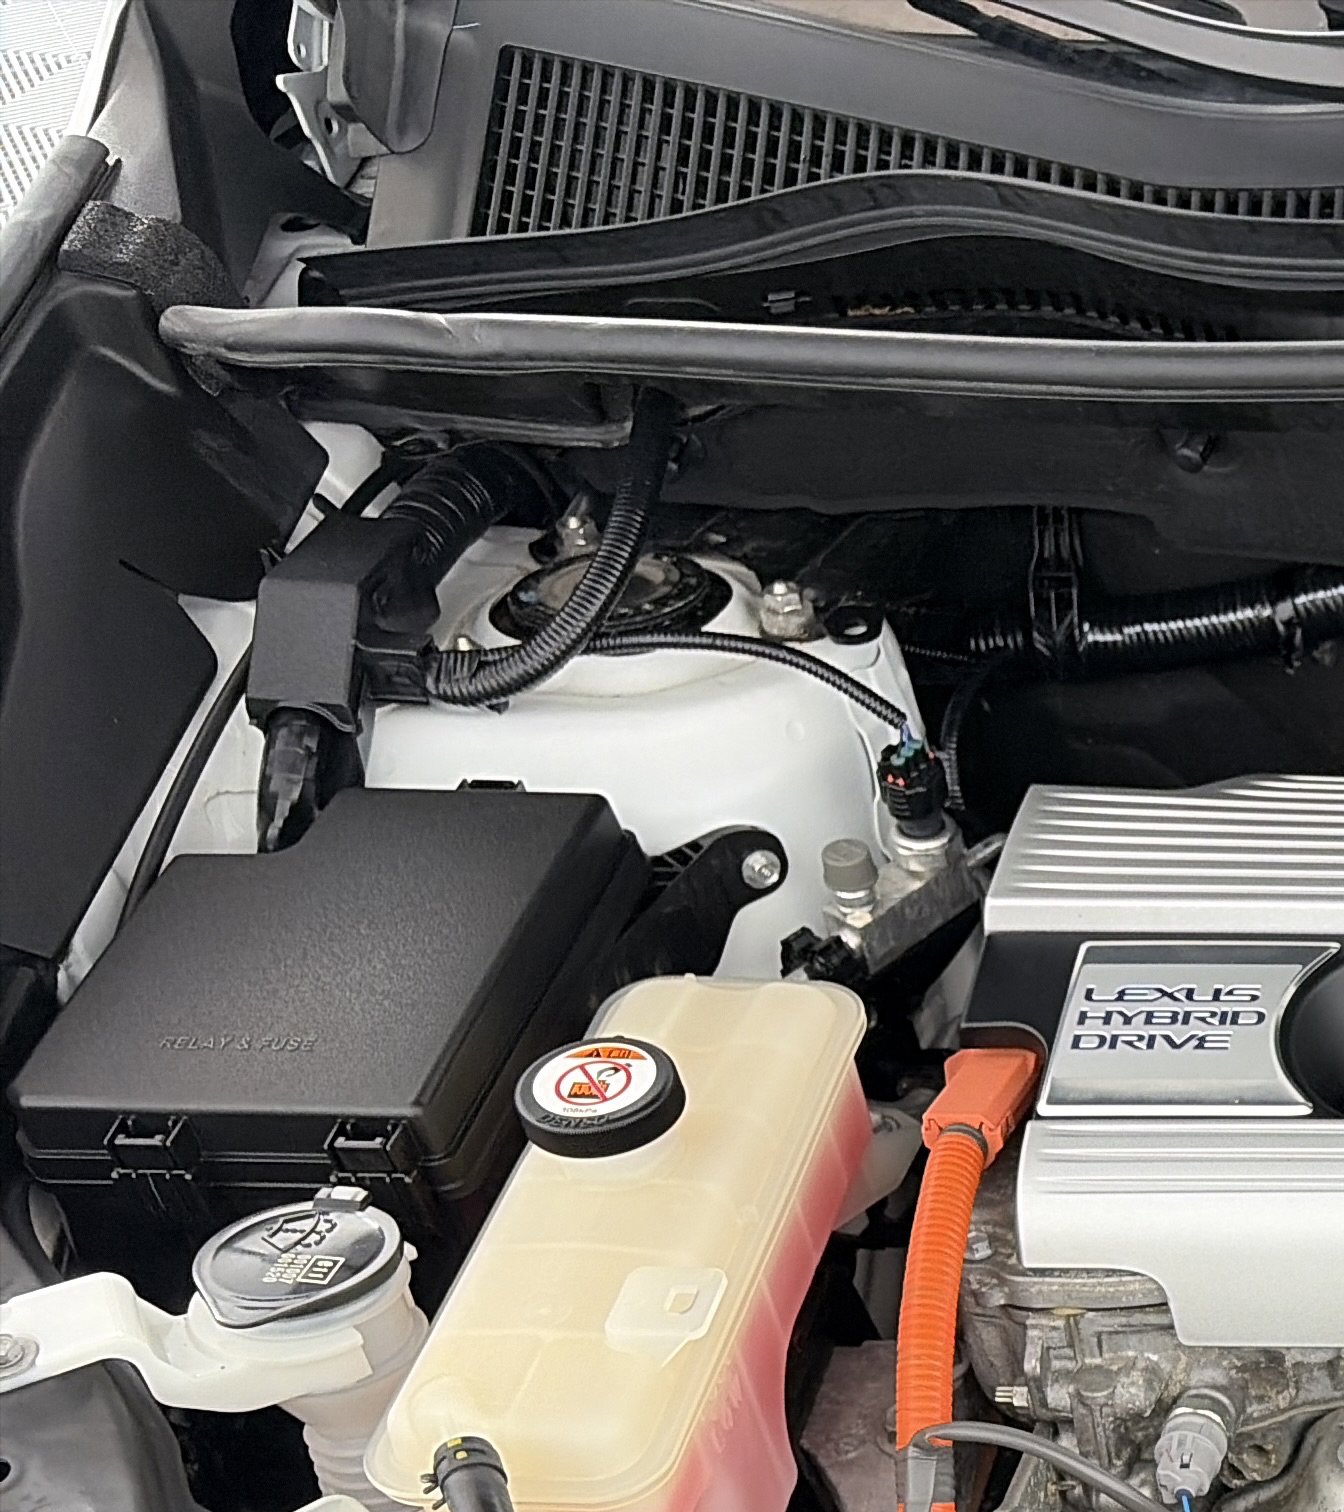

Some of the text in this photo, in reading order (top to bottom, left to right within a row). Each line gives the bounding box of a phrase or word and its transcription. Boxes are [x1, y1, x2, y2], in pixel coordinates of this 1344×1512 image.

[1084, 984, 1262, 1003] LEXUS
[1076, 1007, 1267, 1026] HYBRID
[159, 1034, 318, 1051] RELAY & FUSE
[1070, 1031, 1234, 1050] DRIVE
